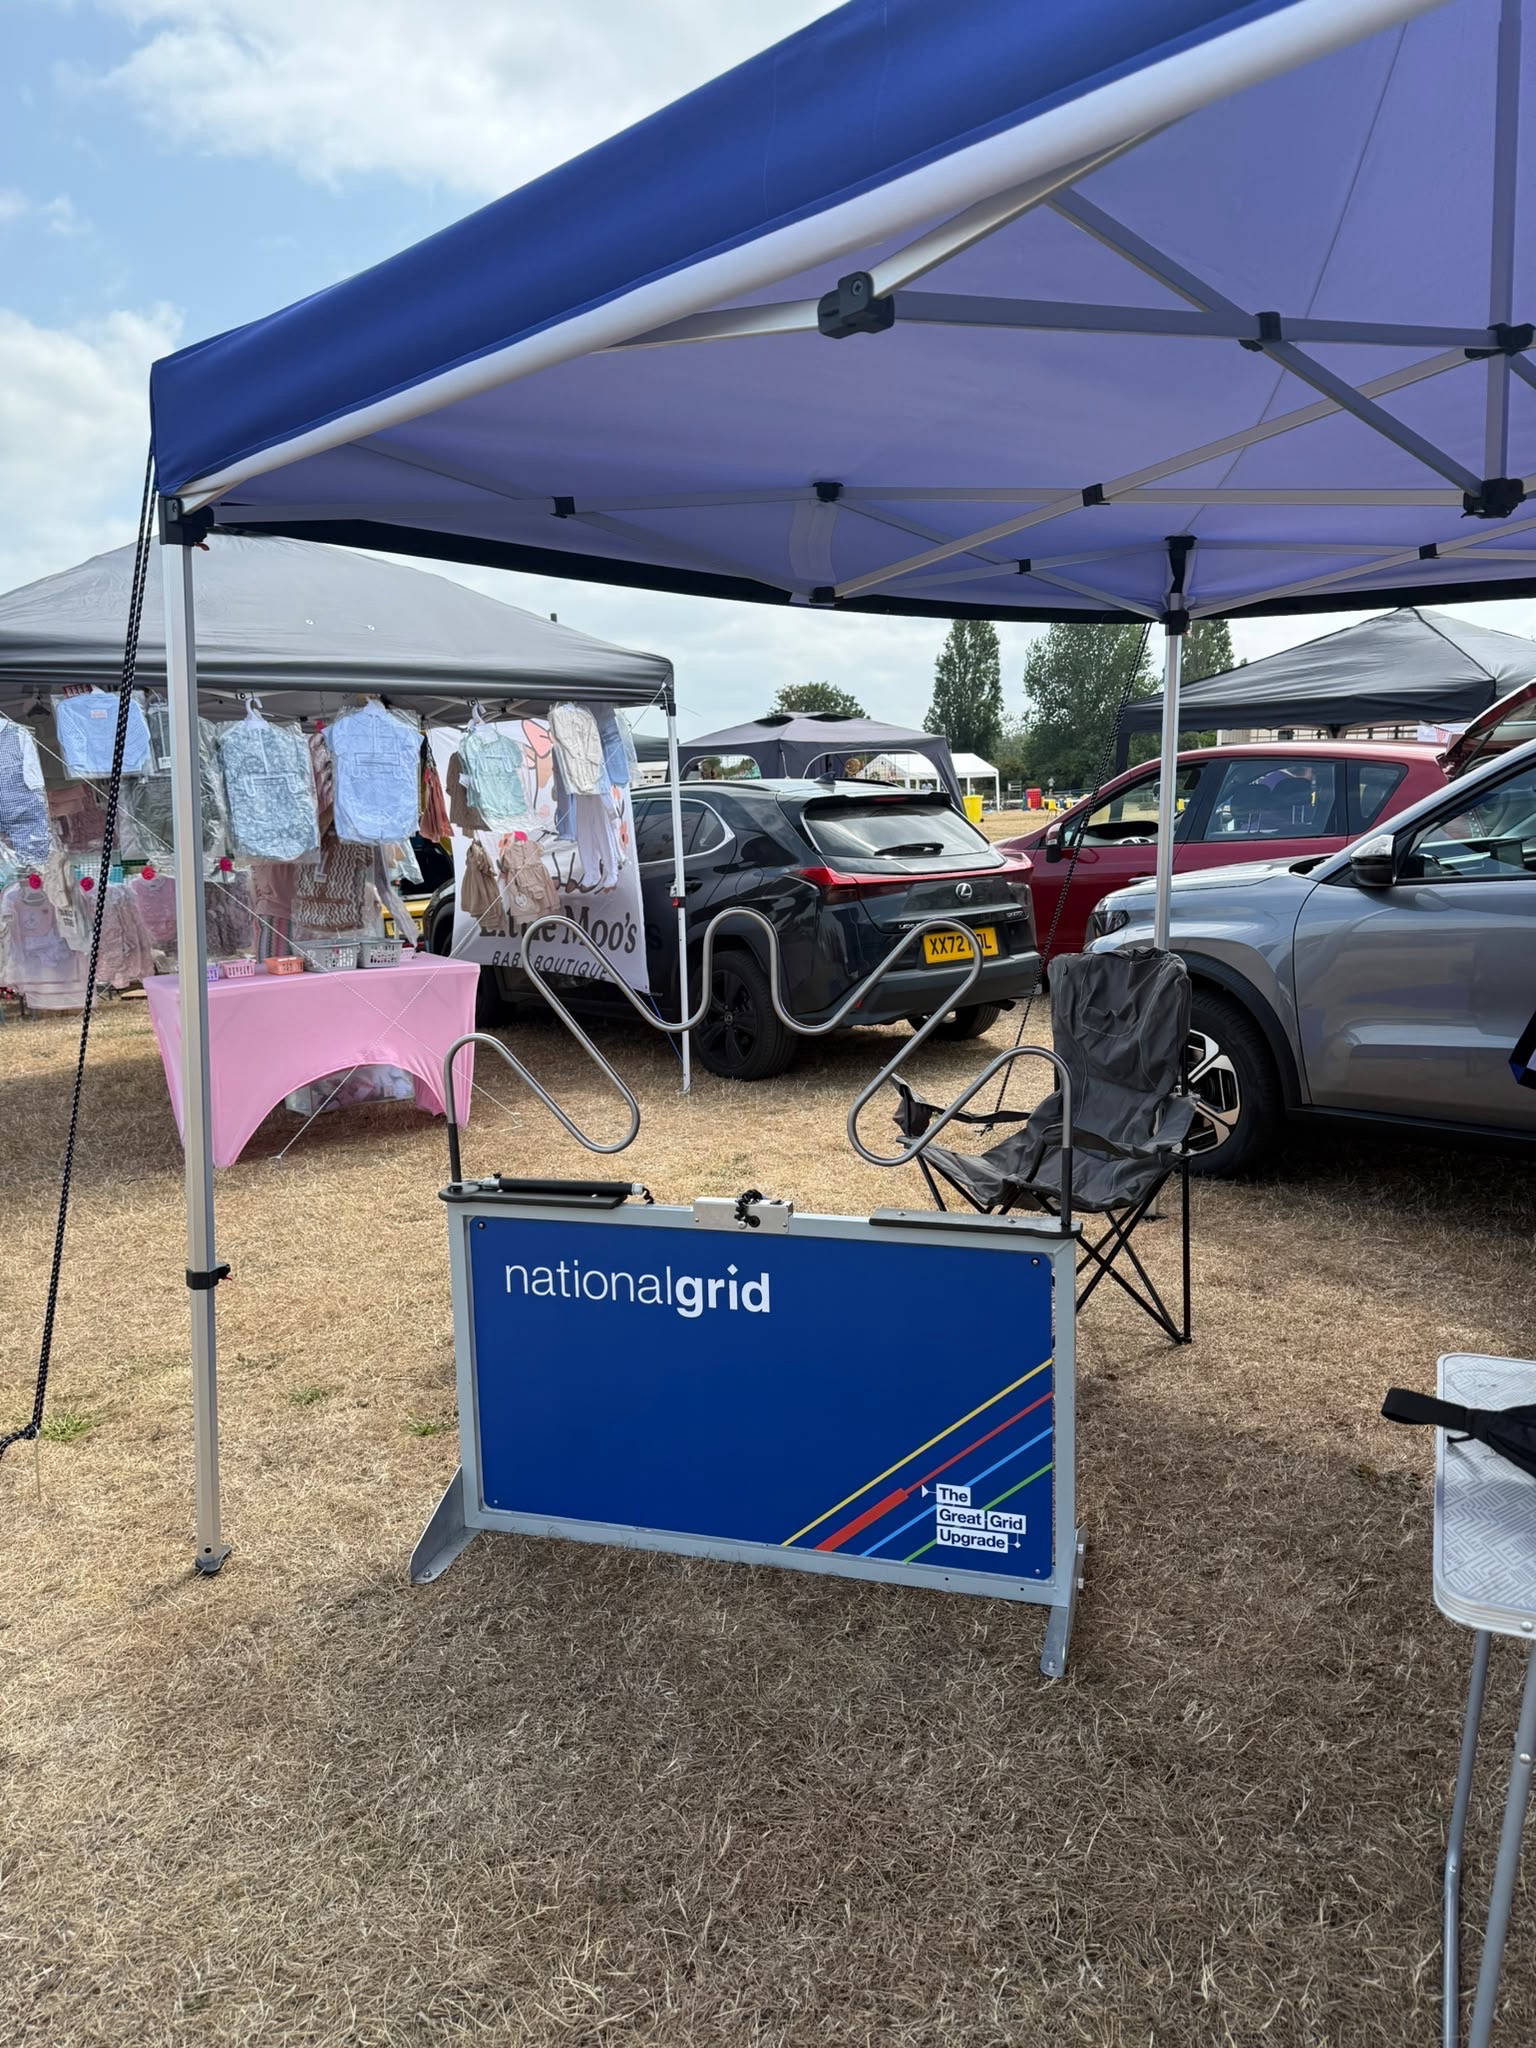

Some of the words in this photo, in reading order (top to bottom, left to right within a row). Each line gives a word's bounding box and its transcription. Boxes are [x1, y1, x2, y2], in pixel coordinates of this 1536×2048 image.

[562, 905, 637, 953] Moo's
[929, 935, 965, 955] XX72
[492, 951, 521, 967] BAB
[939, 1487, 968, 1503] The
[939, 1508, 982, 1526] Great
[990, 1515, 1023, 1531] Grid
[940, 1528, 1006, 1549] Upgrade
